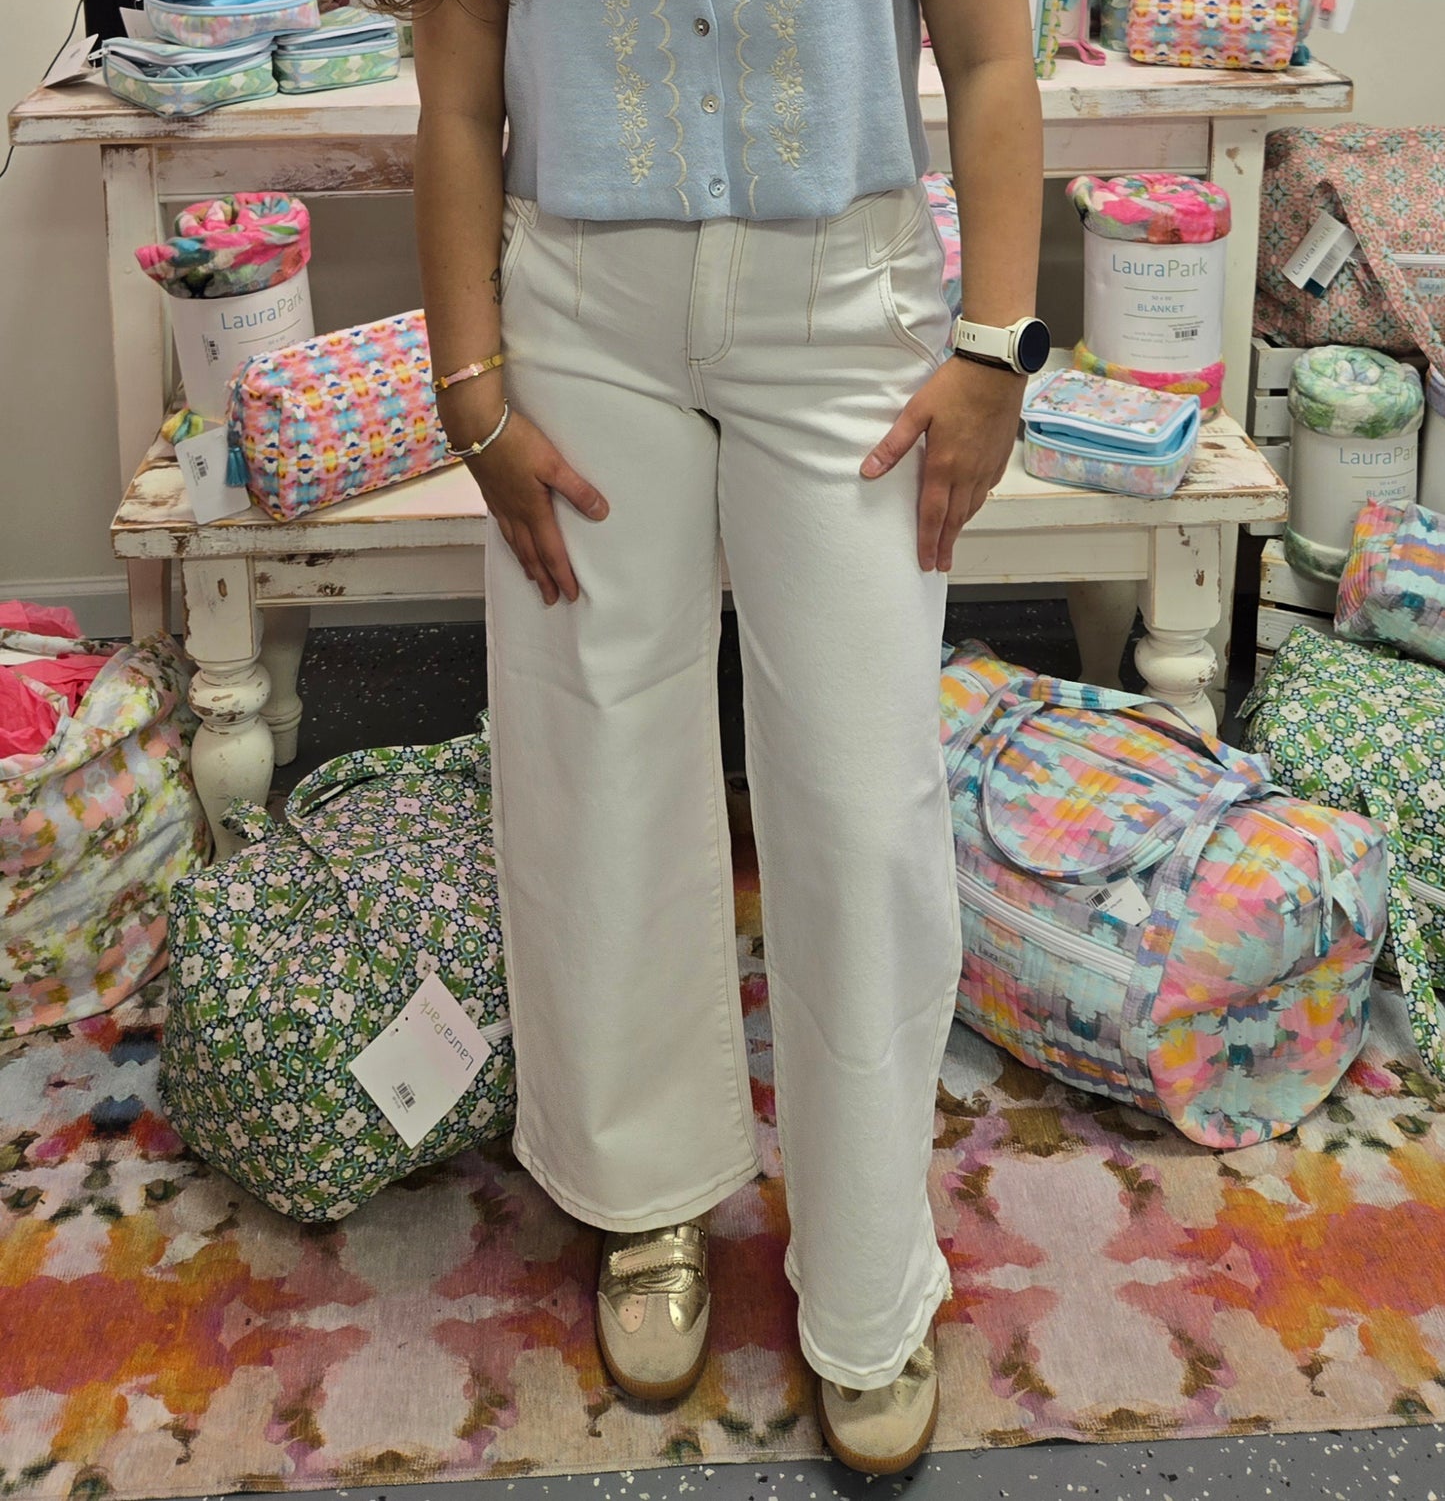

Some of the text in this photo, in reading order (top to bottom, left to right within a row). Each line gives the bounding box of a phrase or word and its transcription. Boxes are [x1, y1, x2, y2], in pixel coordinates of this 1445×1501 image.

[1112, 254, 1208, 278] LauraPark
[221, 286, 304, 330] LauraPark
[1137, 303, 1185, 314] BLANKET
